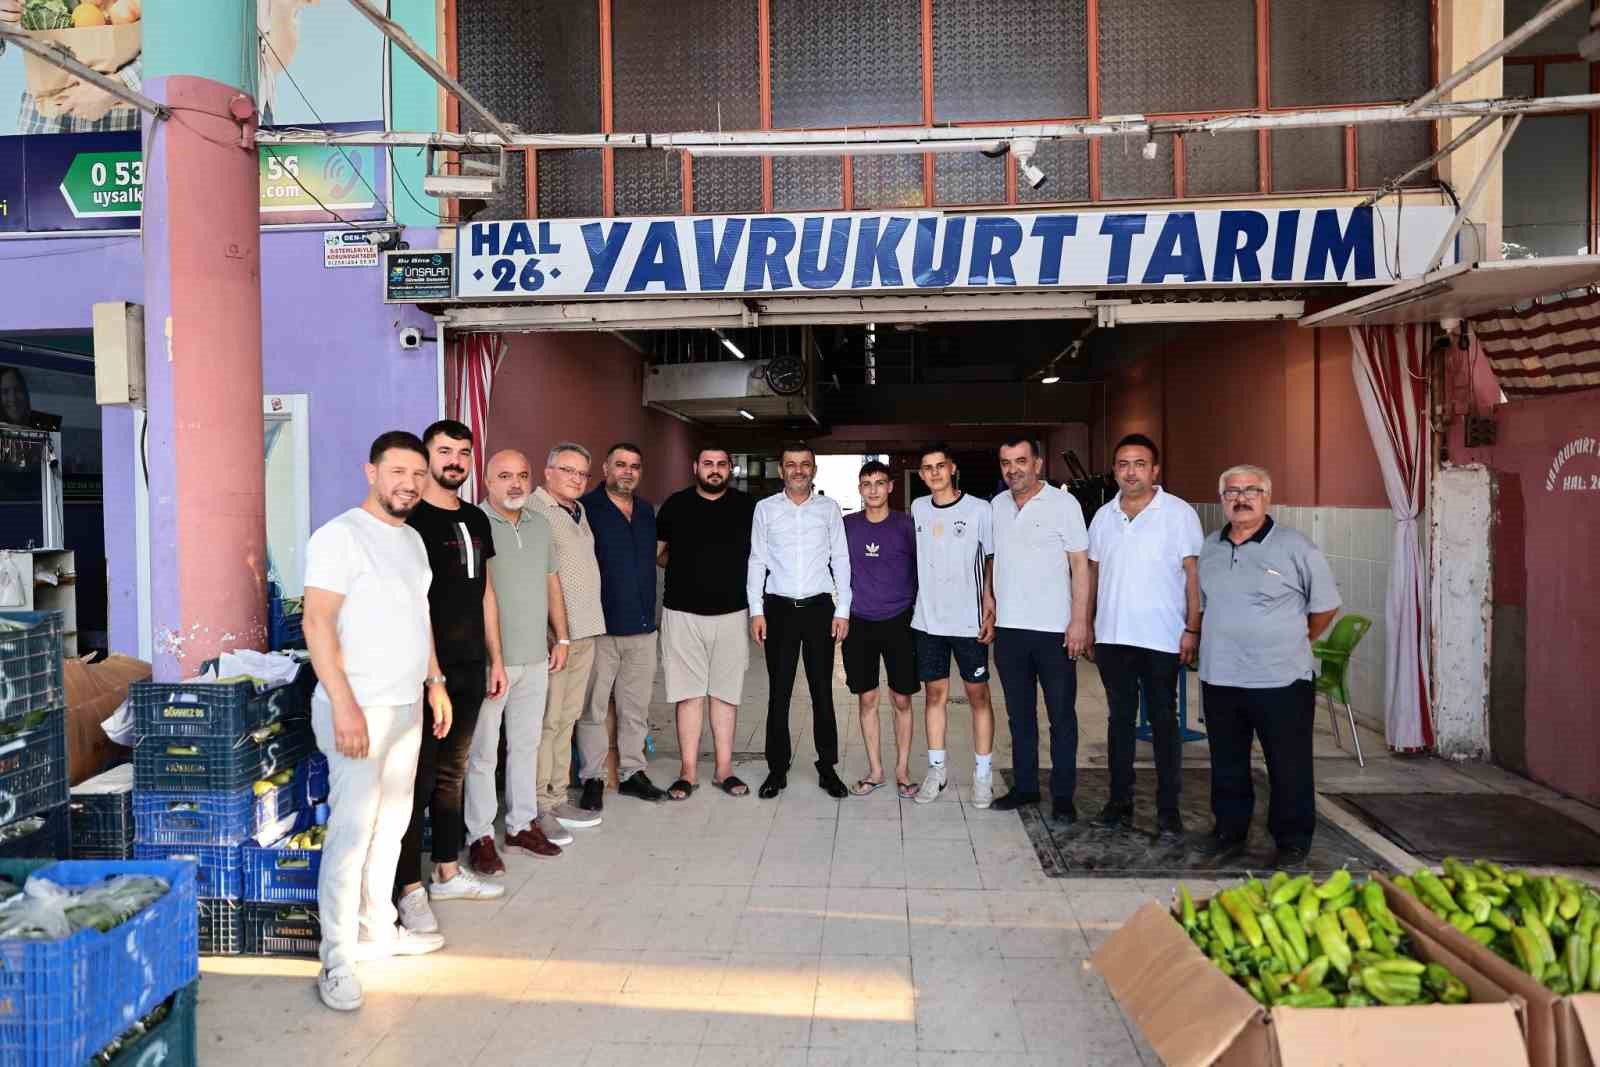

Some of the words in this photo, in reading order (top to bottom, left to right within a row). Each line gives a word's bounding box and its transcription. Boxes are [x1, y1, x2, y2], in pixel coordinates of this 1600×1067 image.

[91, 162, 107, 187] 0
[267, 155, 300, 180] 56
[471, 221, 561, 256] HAL
[580, 214, 1078, 293] YAVRUKURT
[1099, 206, 1377, 285] TARIM
[491, 258, 547, 292] 26
